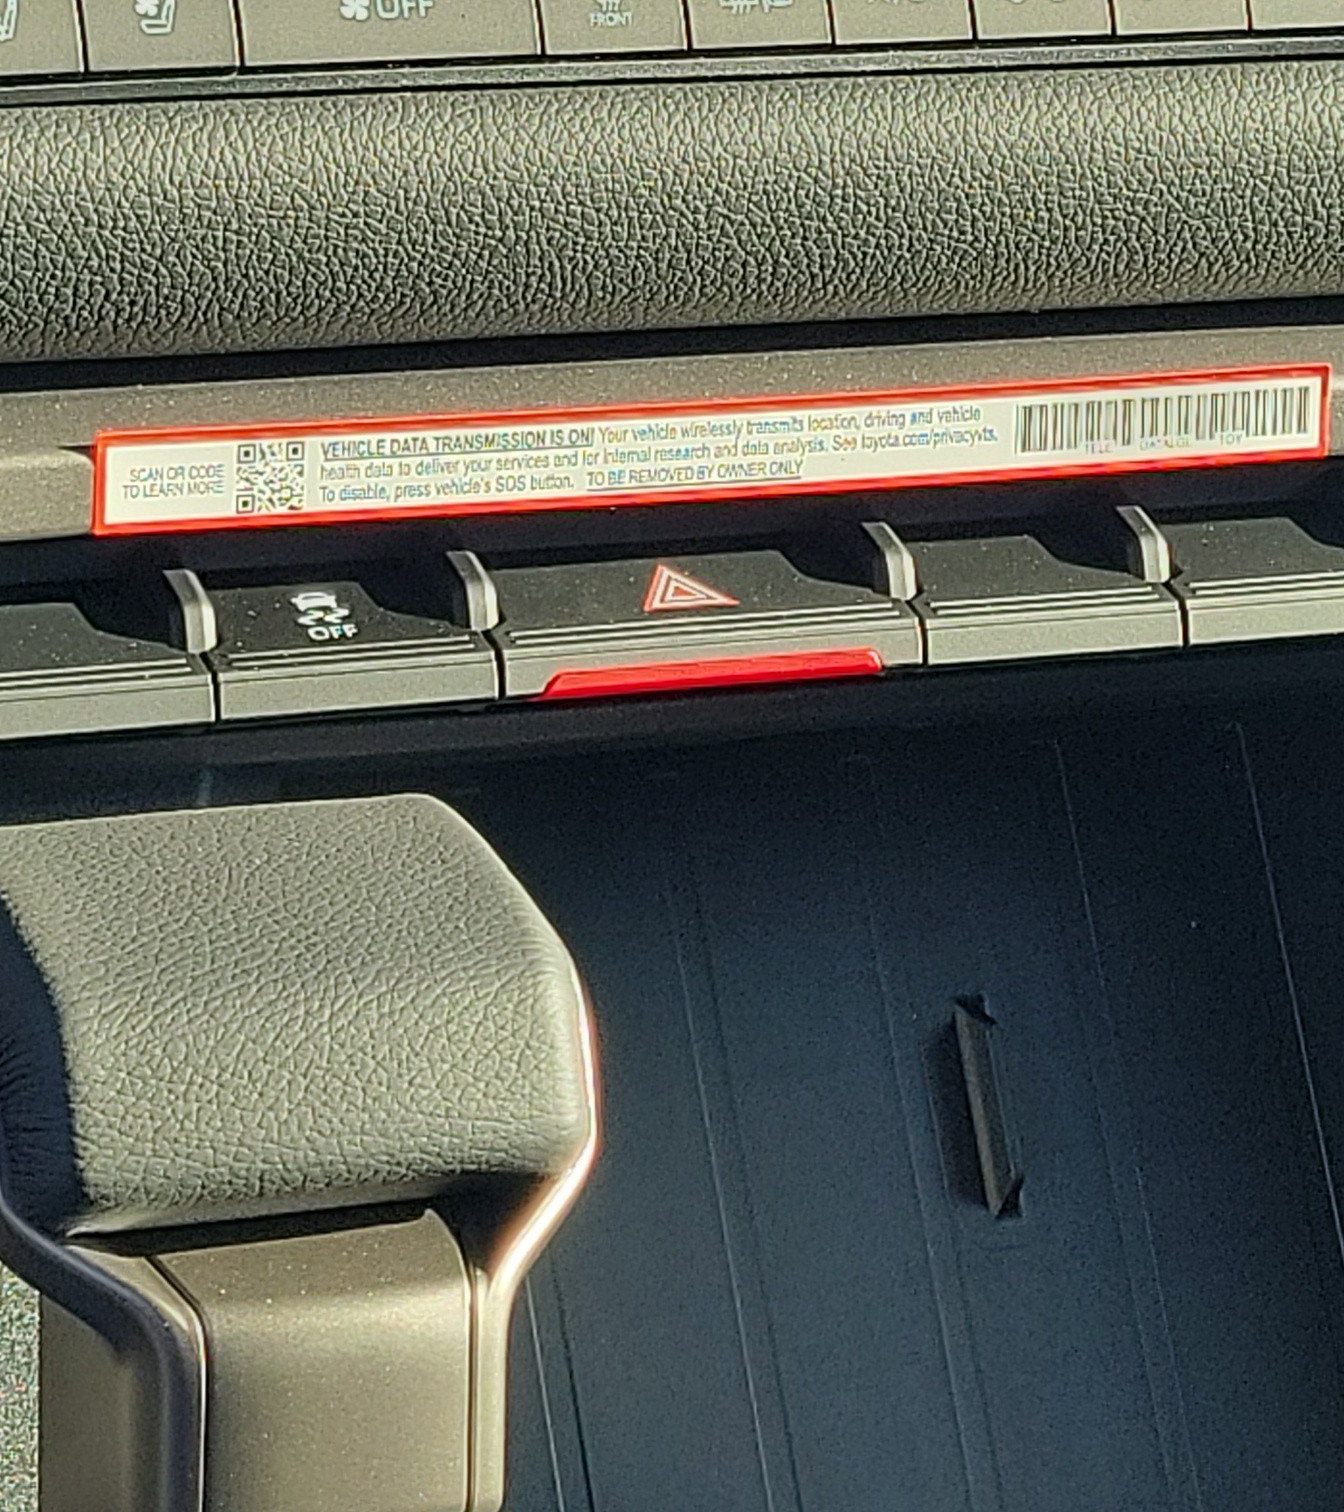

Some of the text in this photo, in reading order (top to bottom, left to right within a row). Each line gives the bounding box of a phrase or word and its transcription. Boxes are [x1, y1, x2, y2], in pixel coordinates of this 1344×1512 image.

[587, 11, 633, 27] FRONT
[320, 438, 386, 458] VEHICLE
[390, 436, 431, 455] DATA
[433, 430, 547, 452] TRANSMISSION
[550, 429, 565, 445] IS
[598, 426, 629, 444] Your
[863, 410, 906, 429] driving
[496, 453, 549, 471] services
[654, 443, 711, 462] research
[130, 468, 164, 483] SCAN
[319, 487, 335, 502] To
[394, 483, 432, 503] press
[495, 475, 527, 492] SOS
[586, 471, 605, 487] TO
[628, 466, 695, 483] REMOVED
[122, 484, 140, 500] TO
[143, 482, 185, 498] LEARN
[308, 624, 358, 641] OFF
